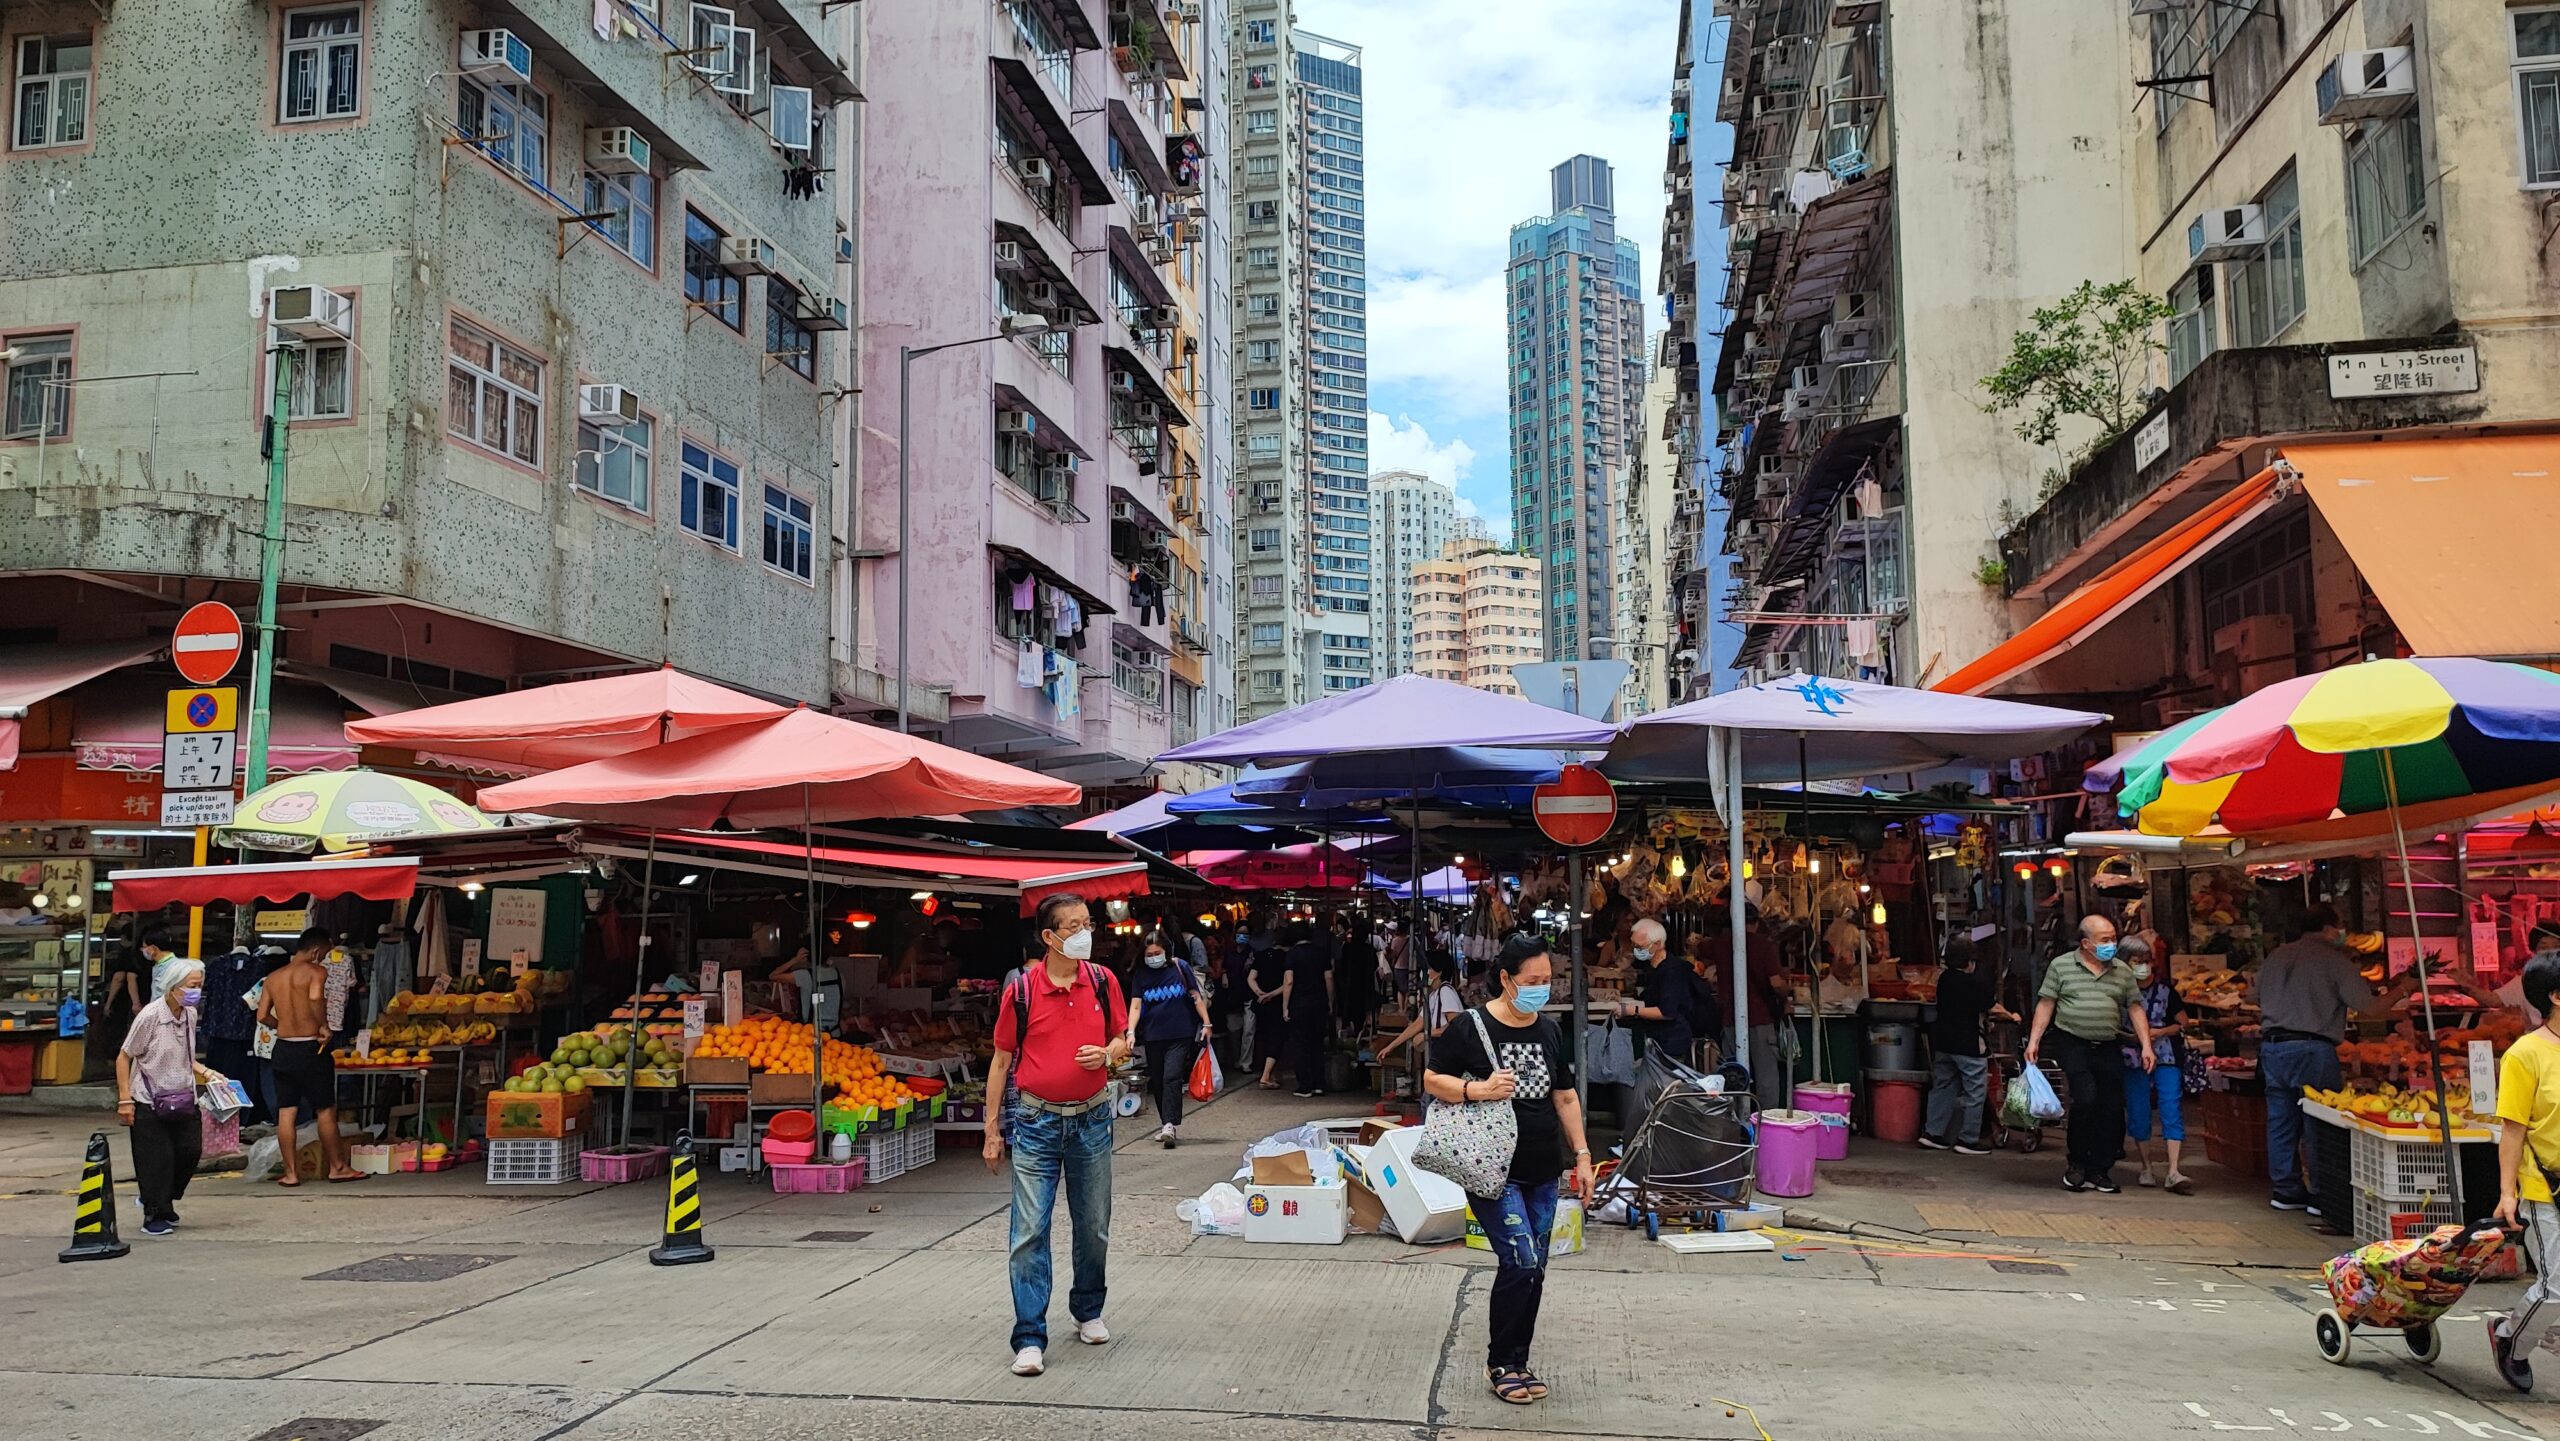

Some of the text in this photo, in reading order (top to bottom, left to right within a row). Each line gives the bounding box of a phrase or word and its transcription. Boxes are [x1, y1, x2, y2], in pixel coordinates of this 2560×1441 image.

[2419, 353, 2465, 366] Street
[2373, 371, 2434, 391] 望隆街
[179, 746, 200, 756] 上午
[211, 736, 223, 755] 7
[182, 765, 196, 773] pm
[210, 765, 222, 783] 7
[179, 774, 199, 784] 下午
[178, 795, 204, 803] Except
[169, 804, 184, 812] pick
[186, 803, 214, 812] up/drop
[165, 812, 229, 824] 的士上落客除外
